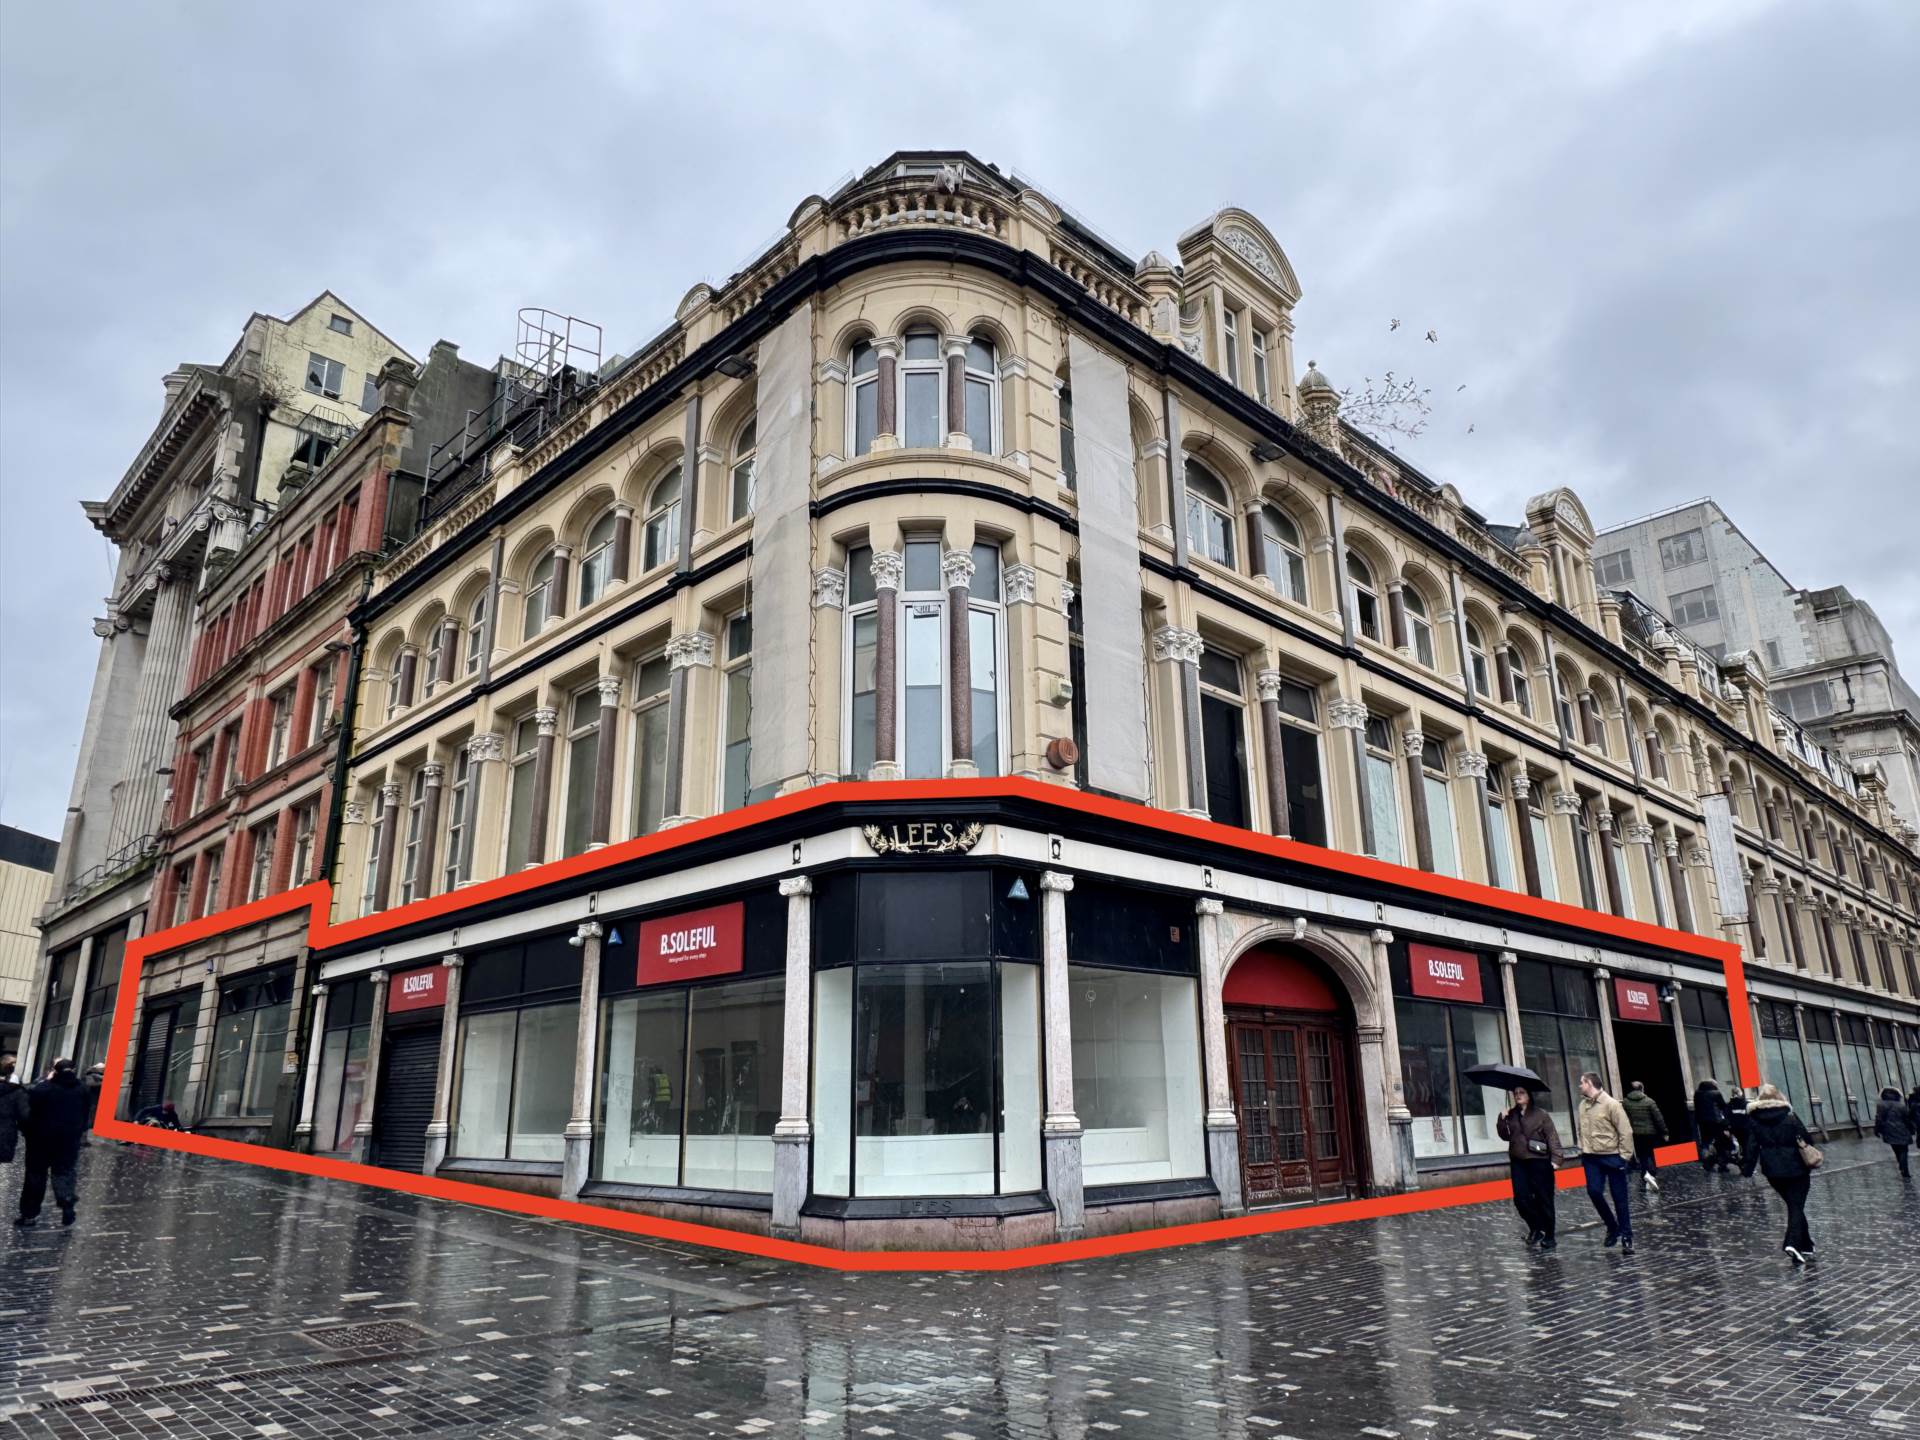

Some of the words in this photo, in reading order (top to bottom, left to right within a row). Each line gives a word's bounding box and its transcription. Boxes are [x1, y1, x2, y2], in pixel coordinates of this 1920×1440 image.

[892, 823, 955, 848] LEE'S
[660, 925, 717, 955] B.SOLEFUL
[1428, 959, 1465, 981] B.SOLEFUL
[899, 1200, 953, 1213] LEES
